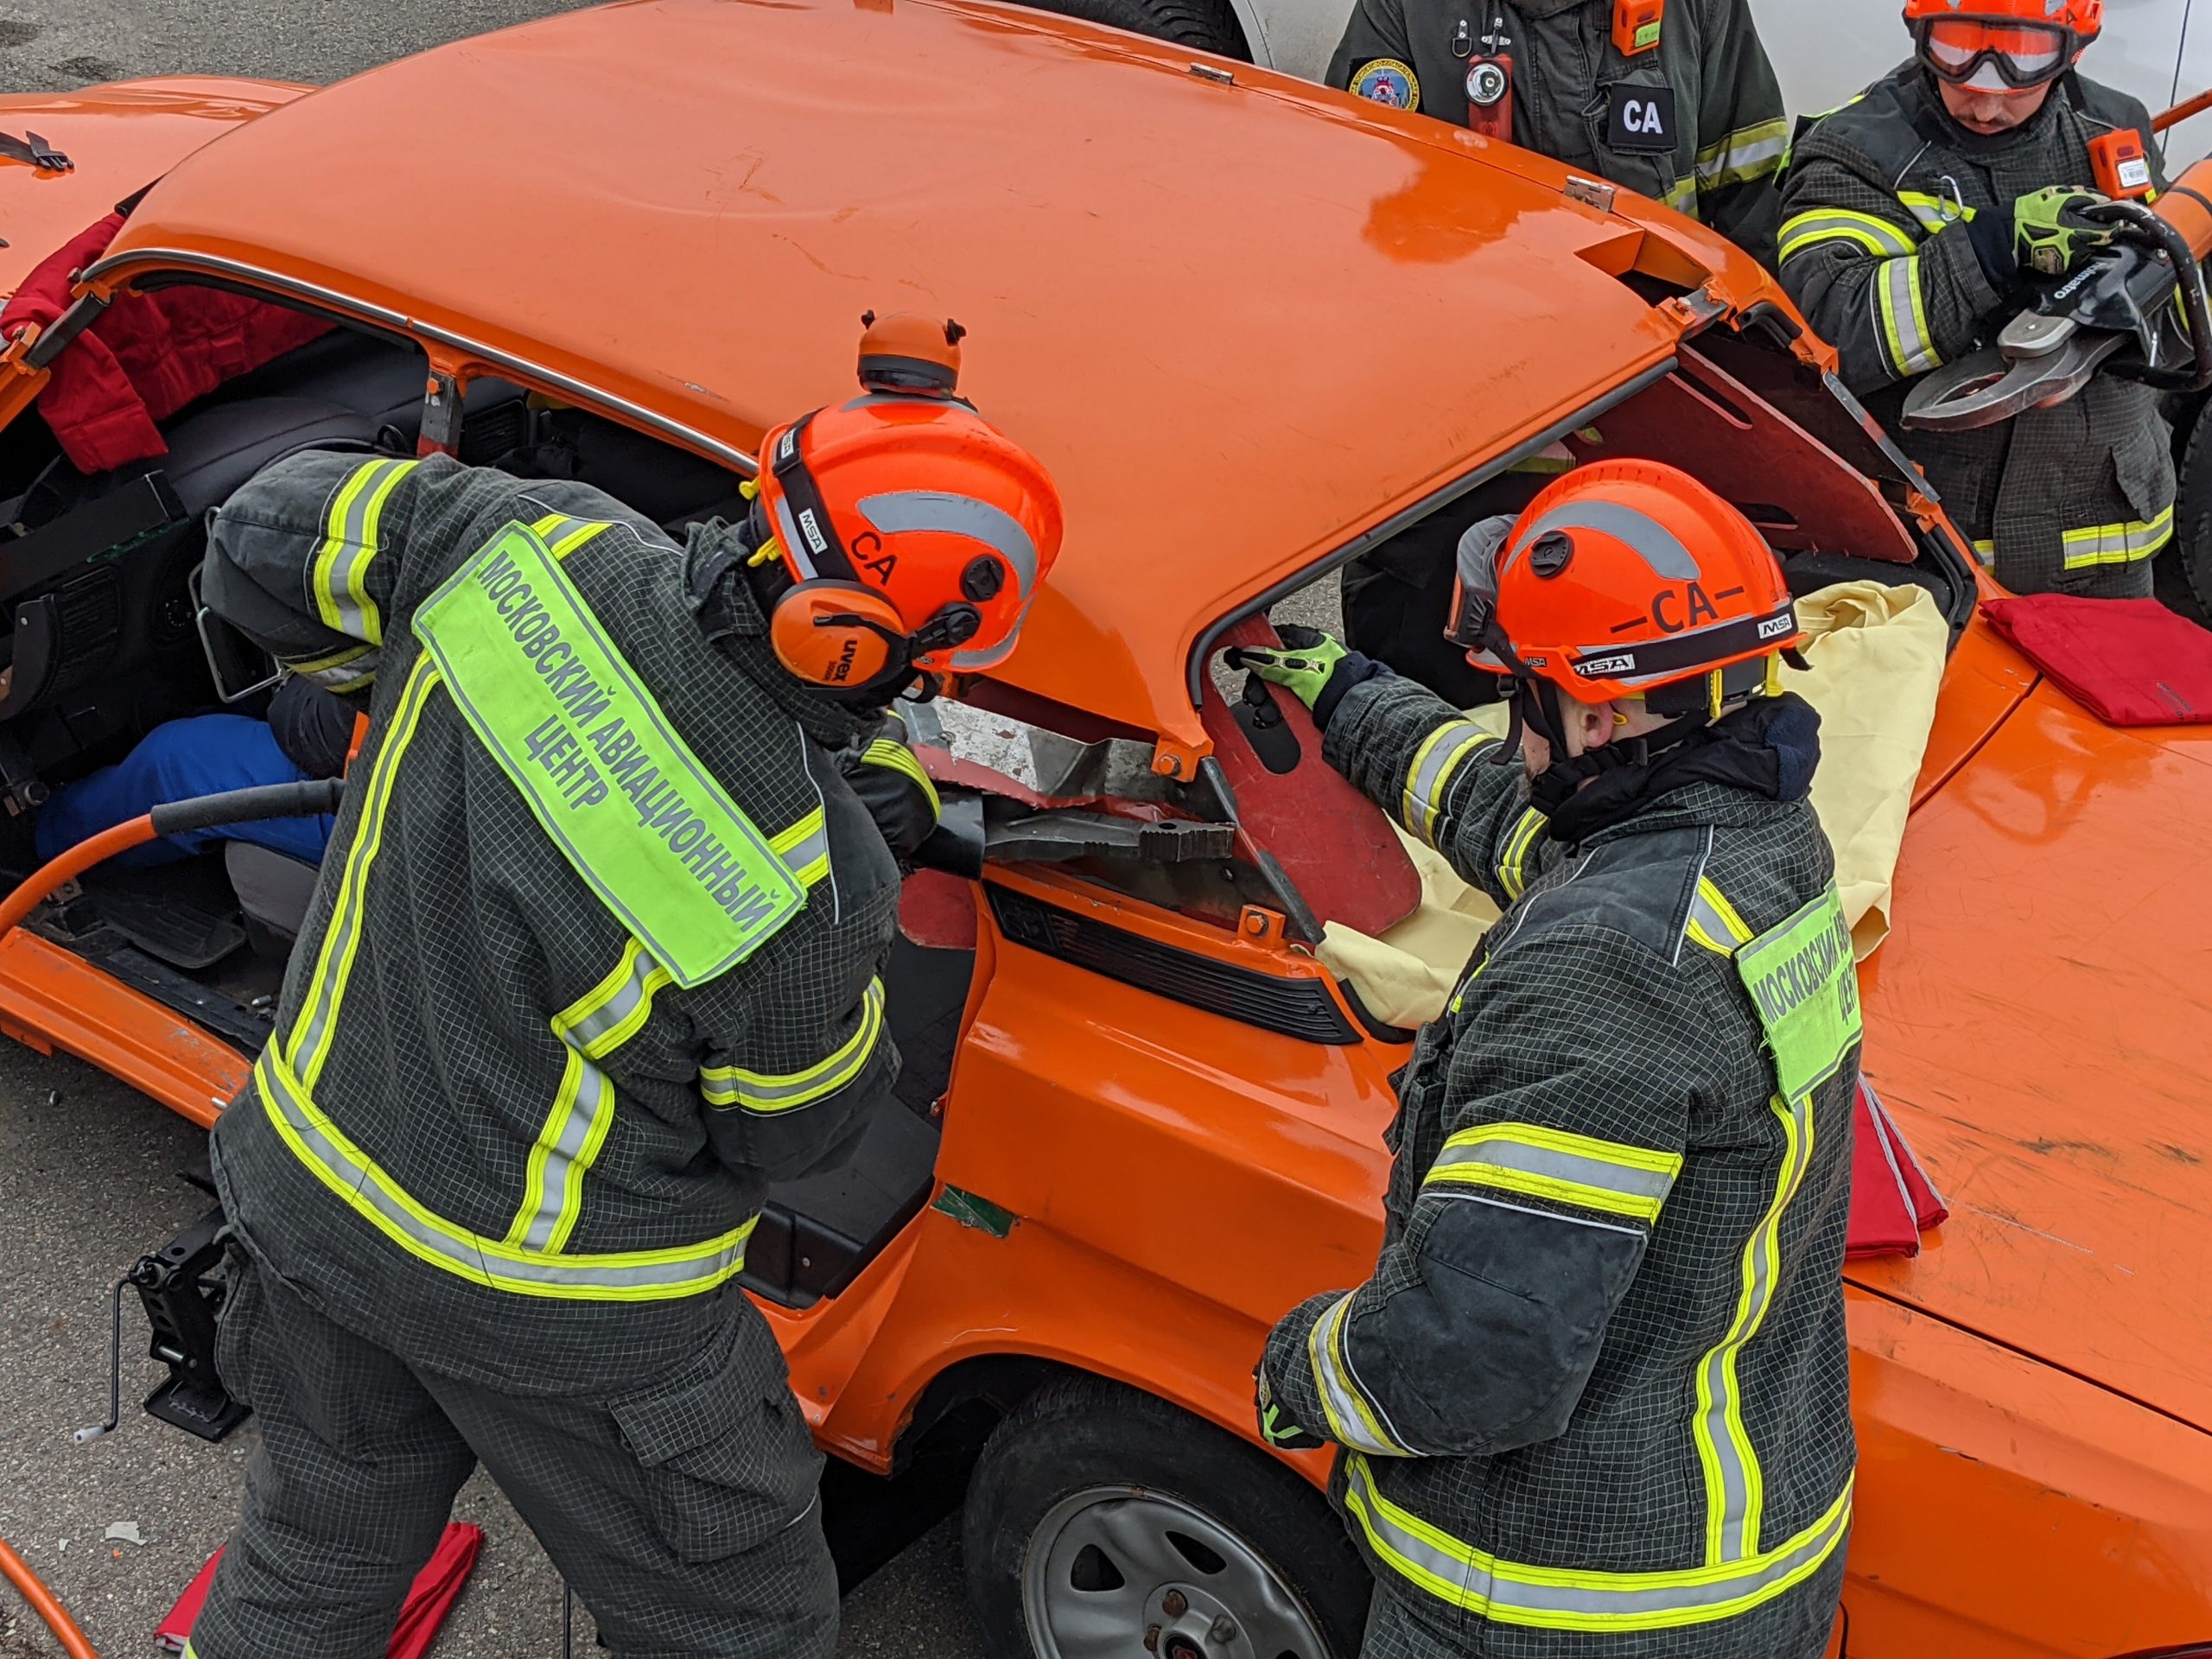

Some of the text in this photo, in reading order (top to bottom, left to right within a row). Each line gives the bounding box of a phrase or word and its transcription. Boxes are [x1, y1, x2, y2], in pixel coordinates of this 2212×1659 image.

[1623, 99, 1663, 134] СА
[783, 429, 793, 456] SA
[802, 514, 822, 550] MSA
[851, 531, 898, 587] СА
[1763, 618, 1790, 638] MSA
[832, 639, 858, 682] uvex
[1524, 658, 1546, 666] MSA
[477, 550, 781, 933] МОСКОВСКИЙ АВИАЦИОННЫЙ
[524, 714, 609, 810] ЦЕНТР
[1753, 915, 1840, 1023] МОСКОВСКИЙ
